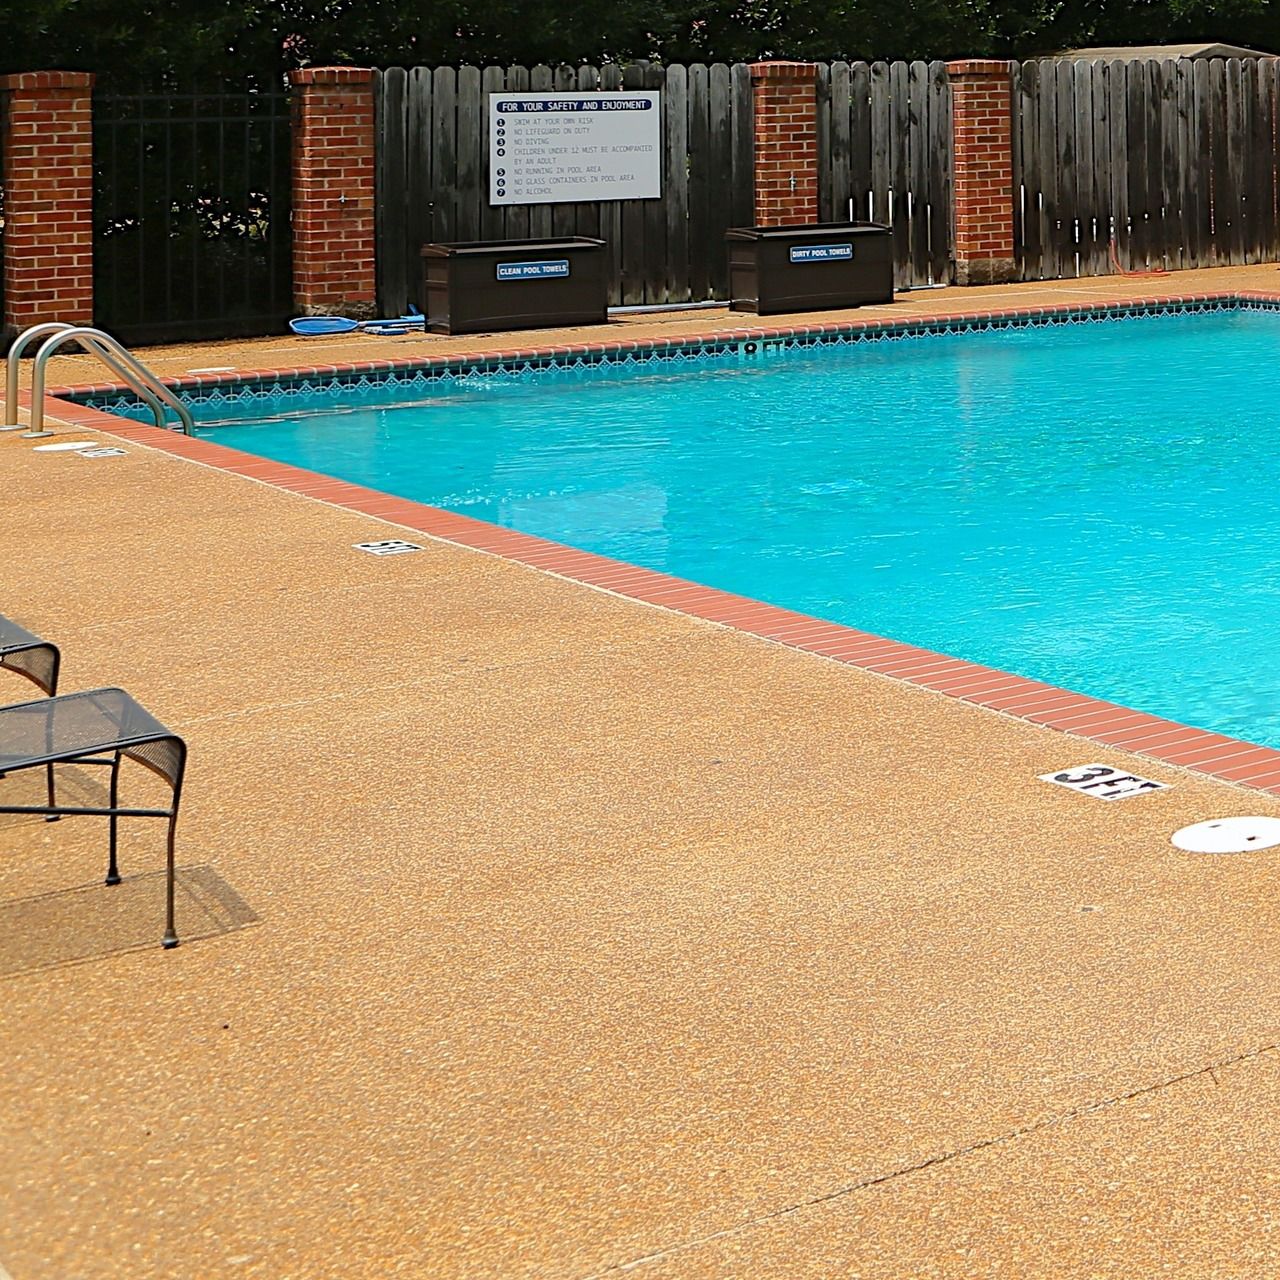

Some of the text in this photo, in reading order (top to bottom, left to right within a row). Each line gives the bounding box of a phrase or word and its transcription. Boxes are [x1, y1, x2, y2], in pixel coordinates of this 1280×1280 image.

[502, 100, 646, 111] FOR YOUR SAFETY AND ENJOYMENT
[526, 127, 561, 135] LIFEGUARD
[574, 126, 590, 134] DUTY
[526, 137, 550, 145] DIVING
[571, 146, 579, 154] 12
[611, 144, 653, 153] ACCOMPANIED
[526, 167, 553, 175] RUNNING
[556, 166, 564, 174] IN
[526, 177, 546, 185] GLASS
[549, 176, 587, 185] CONTAINERS
[619, 174, 635, 182] AREA
[526, 187, 552, 195] ALCOHOL
[792, 247, 851, 258] DIRTY POOL TOWELS
[499, 264, 567, 276] CLEAN POOL TOWELS
